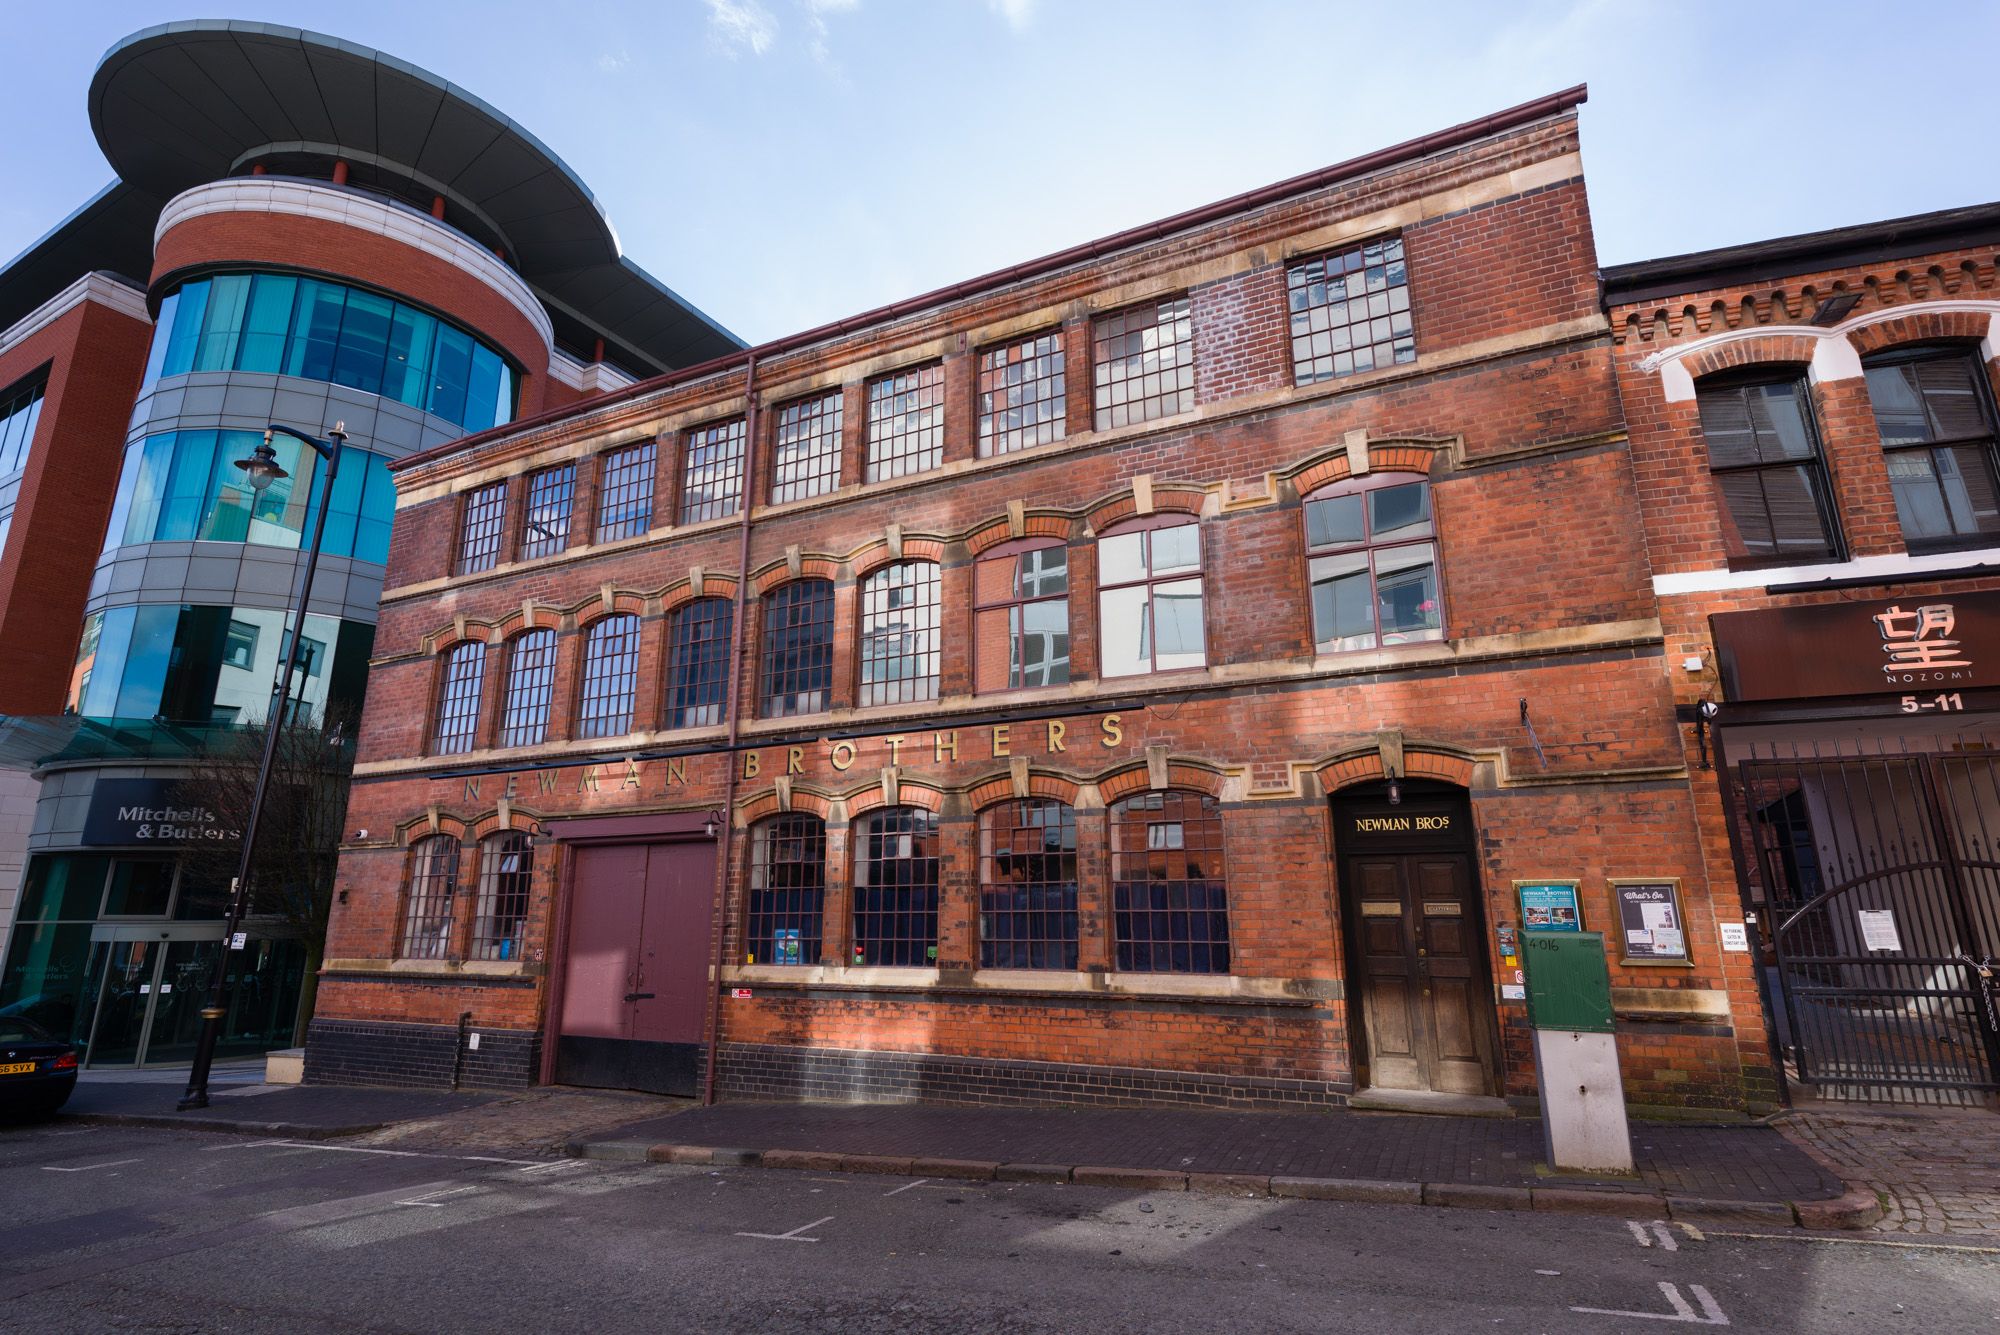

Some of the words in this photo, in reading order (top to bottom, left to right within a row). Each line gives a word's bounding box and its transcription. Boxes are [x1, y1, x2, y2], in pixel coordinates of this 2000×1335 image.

[1873, 604, 1972, 672] 望
[1887, 671, 1972, 683] NOZOMI
[464, 758, 686, 801] NEWMAN
[743, 714, 1122, 779] BROTHERS
[118, 806, 216, 822] Mitchells
[135, 824, 153, 839] &
[1356, 818, 1410, 832] NEWMAN
[1624, 891, 1651, 900] What's
[1651, 891, 1664, 900] On
